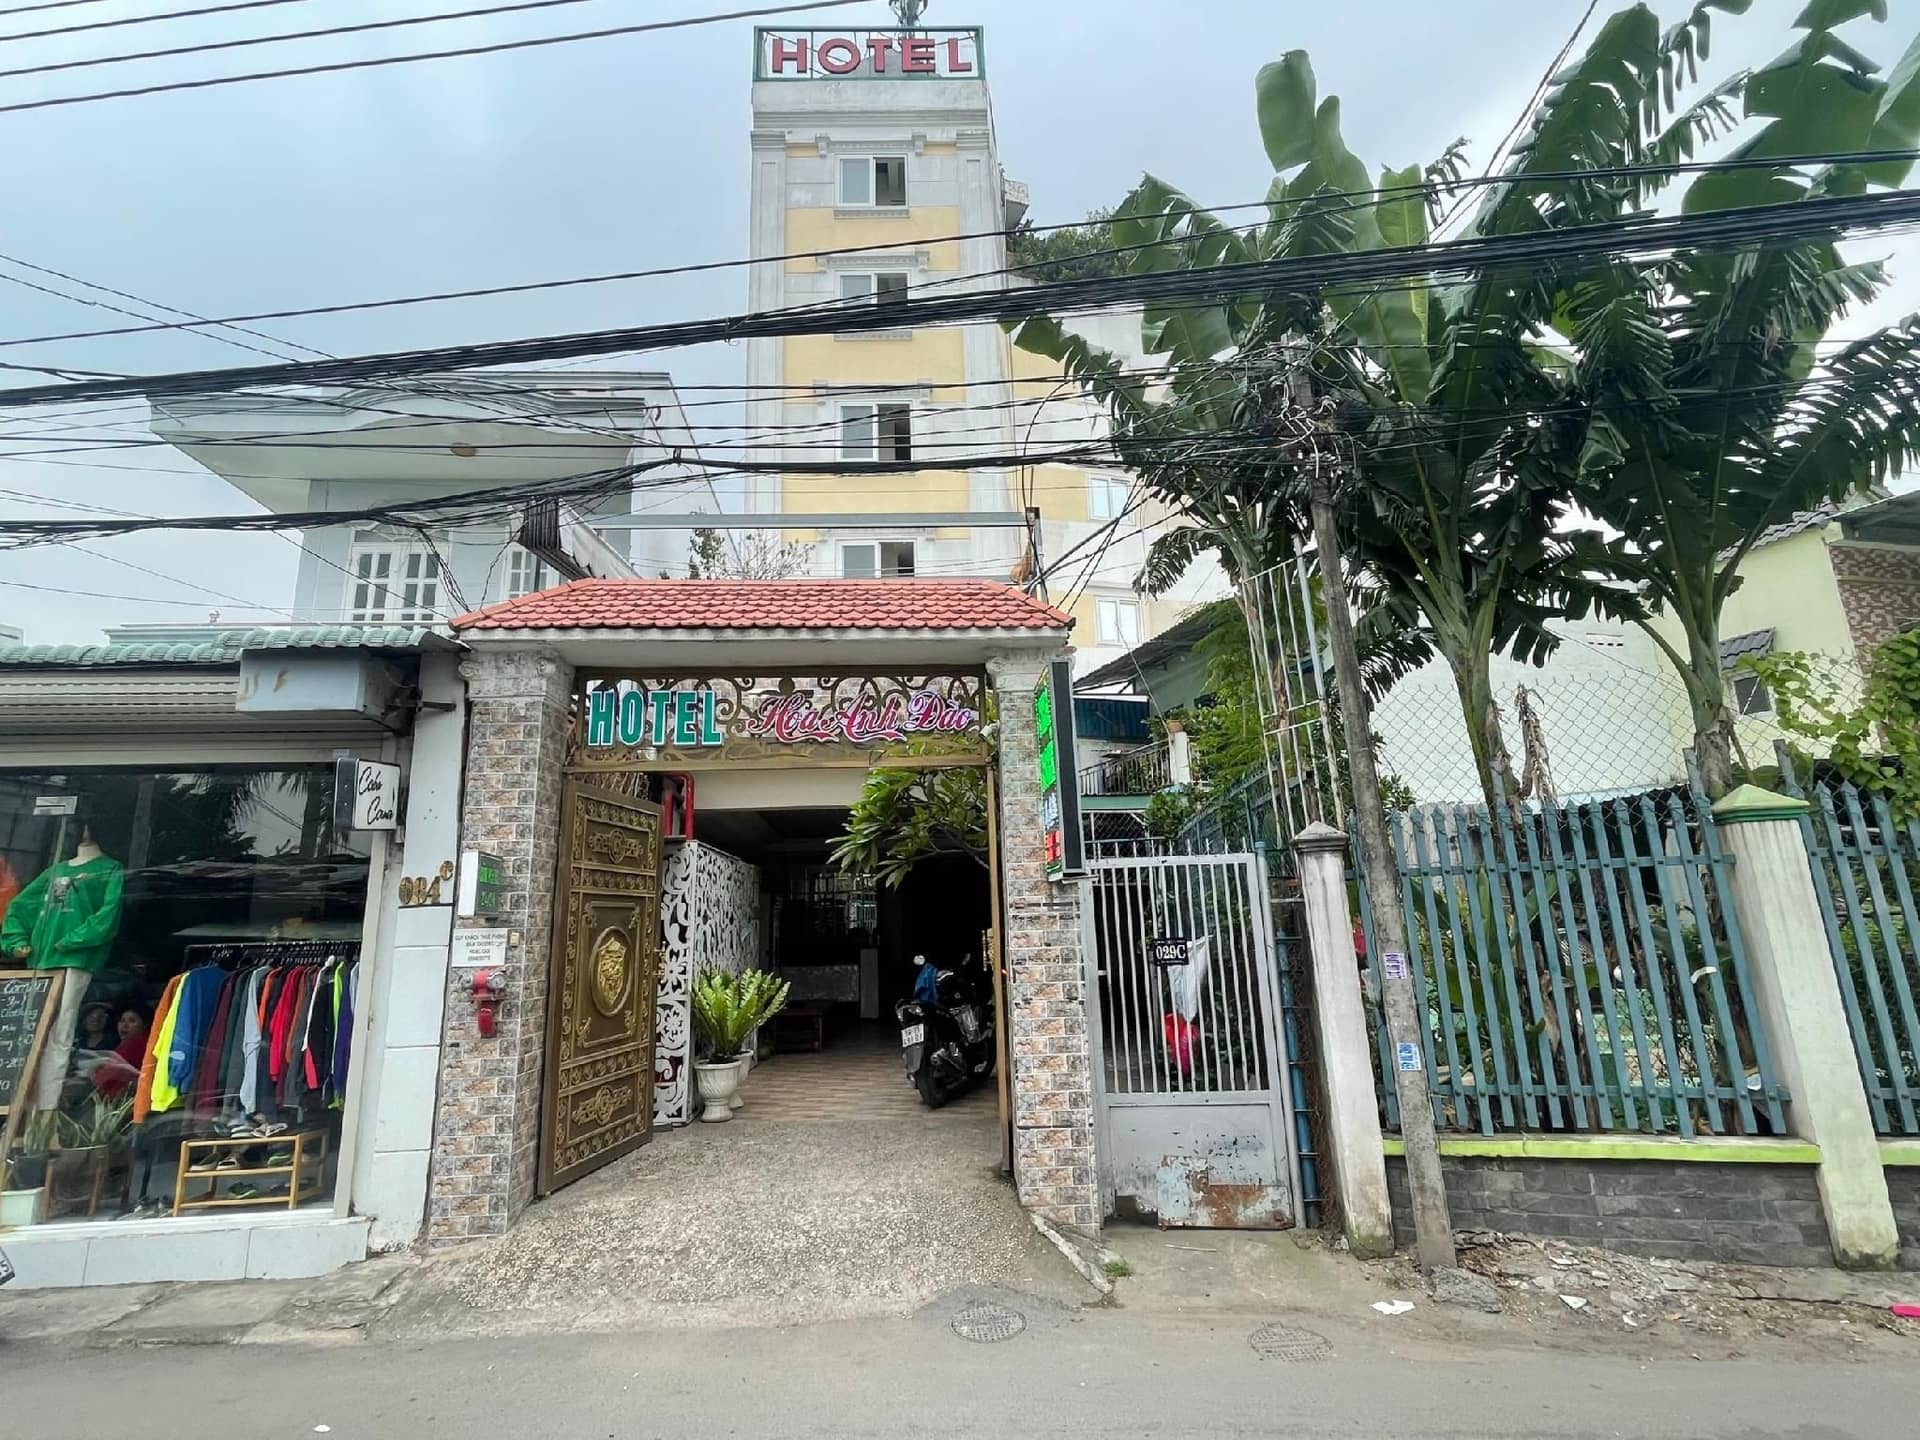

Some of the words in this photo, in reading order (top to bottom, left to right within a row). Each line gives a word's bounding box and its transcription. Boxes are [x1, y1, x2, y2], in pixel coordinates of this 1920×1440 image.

[772, 38, 972, 74] HOTEL
[588, 690, 722, 746] HOTEL
[746, 694, 839, 742] Hoa
[1156, 944, 1186, 960] 029C
